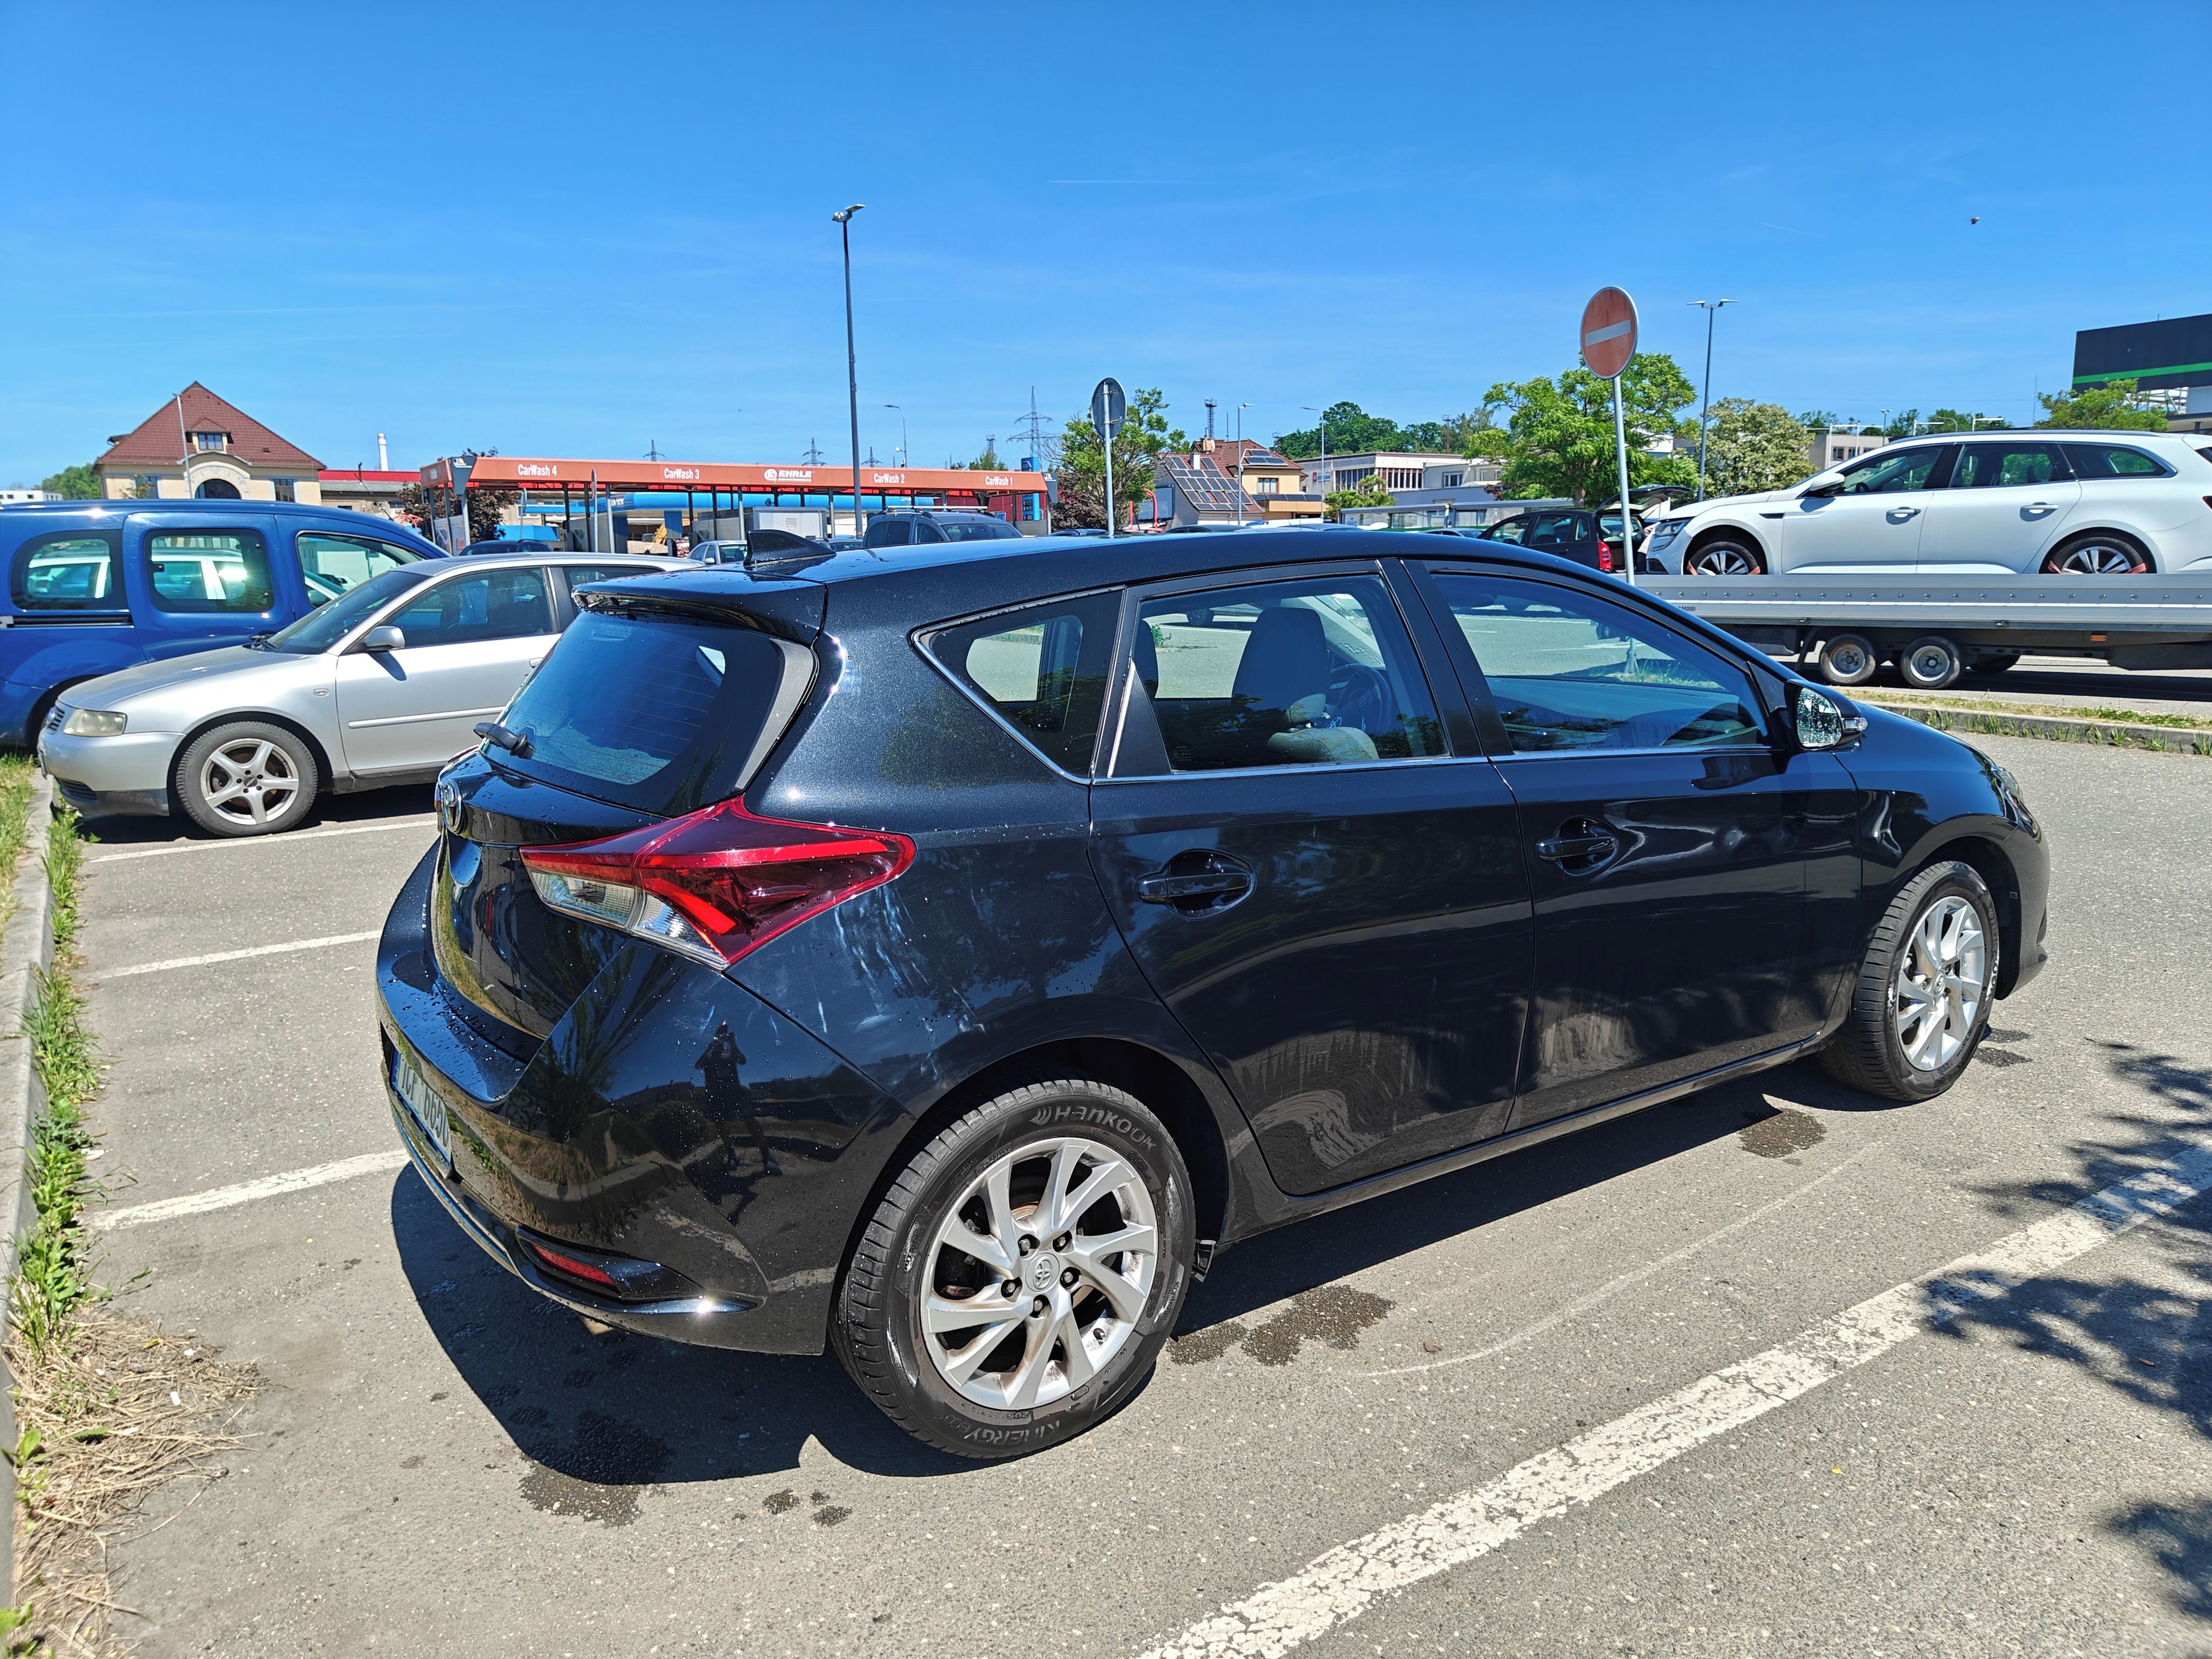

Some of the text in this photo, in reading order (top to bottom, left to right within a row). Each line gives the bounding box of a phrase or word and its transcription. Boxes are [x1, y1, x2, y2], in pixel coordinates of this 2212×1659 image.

[518, 463, 557, 477] CarWash 4
[664, 467, 700, 480] CarWash 3
[778, 469, 813, 478] EHRLE
[873, 473, 905, 484] CarWash 2
[985, 475, 1014, 487] CarWash 1
